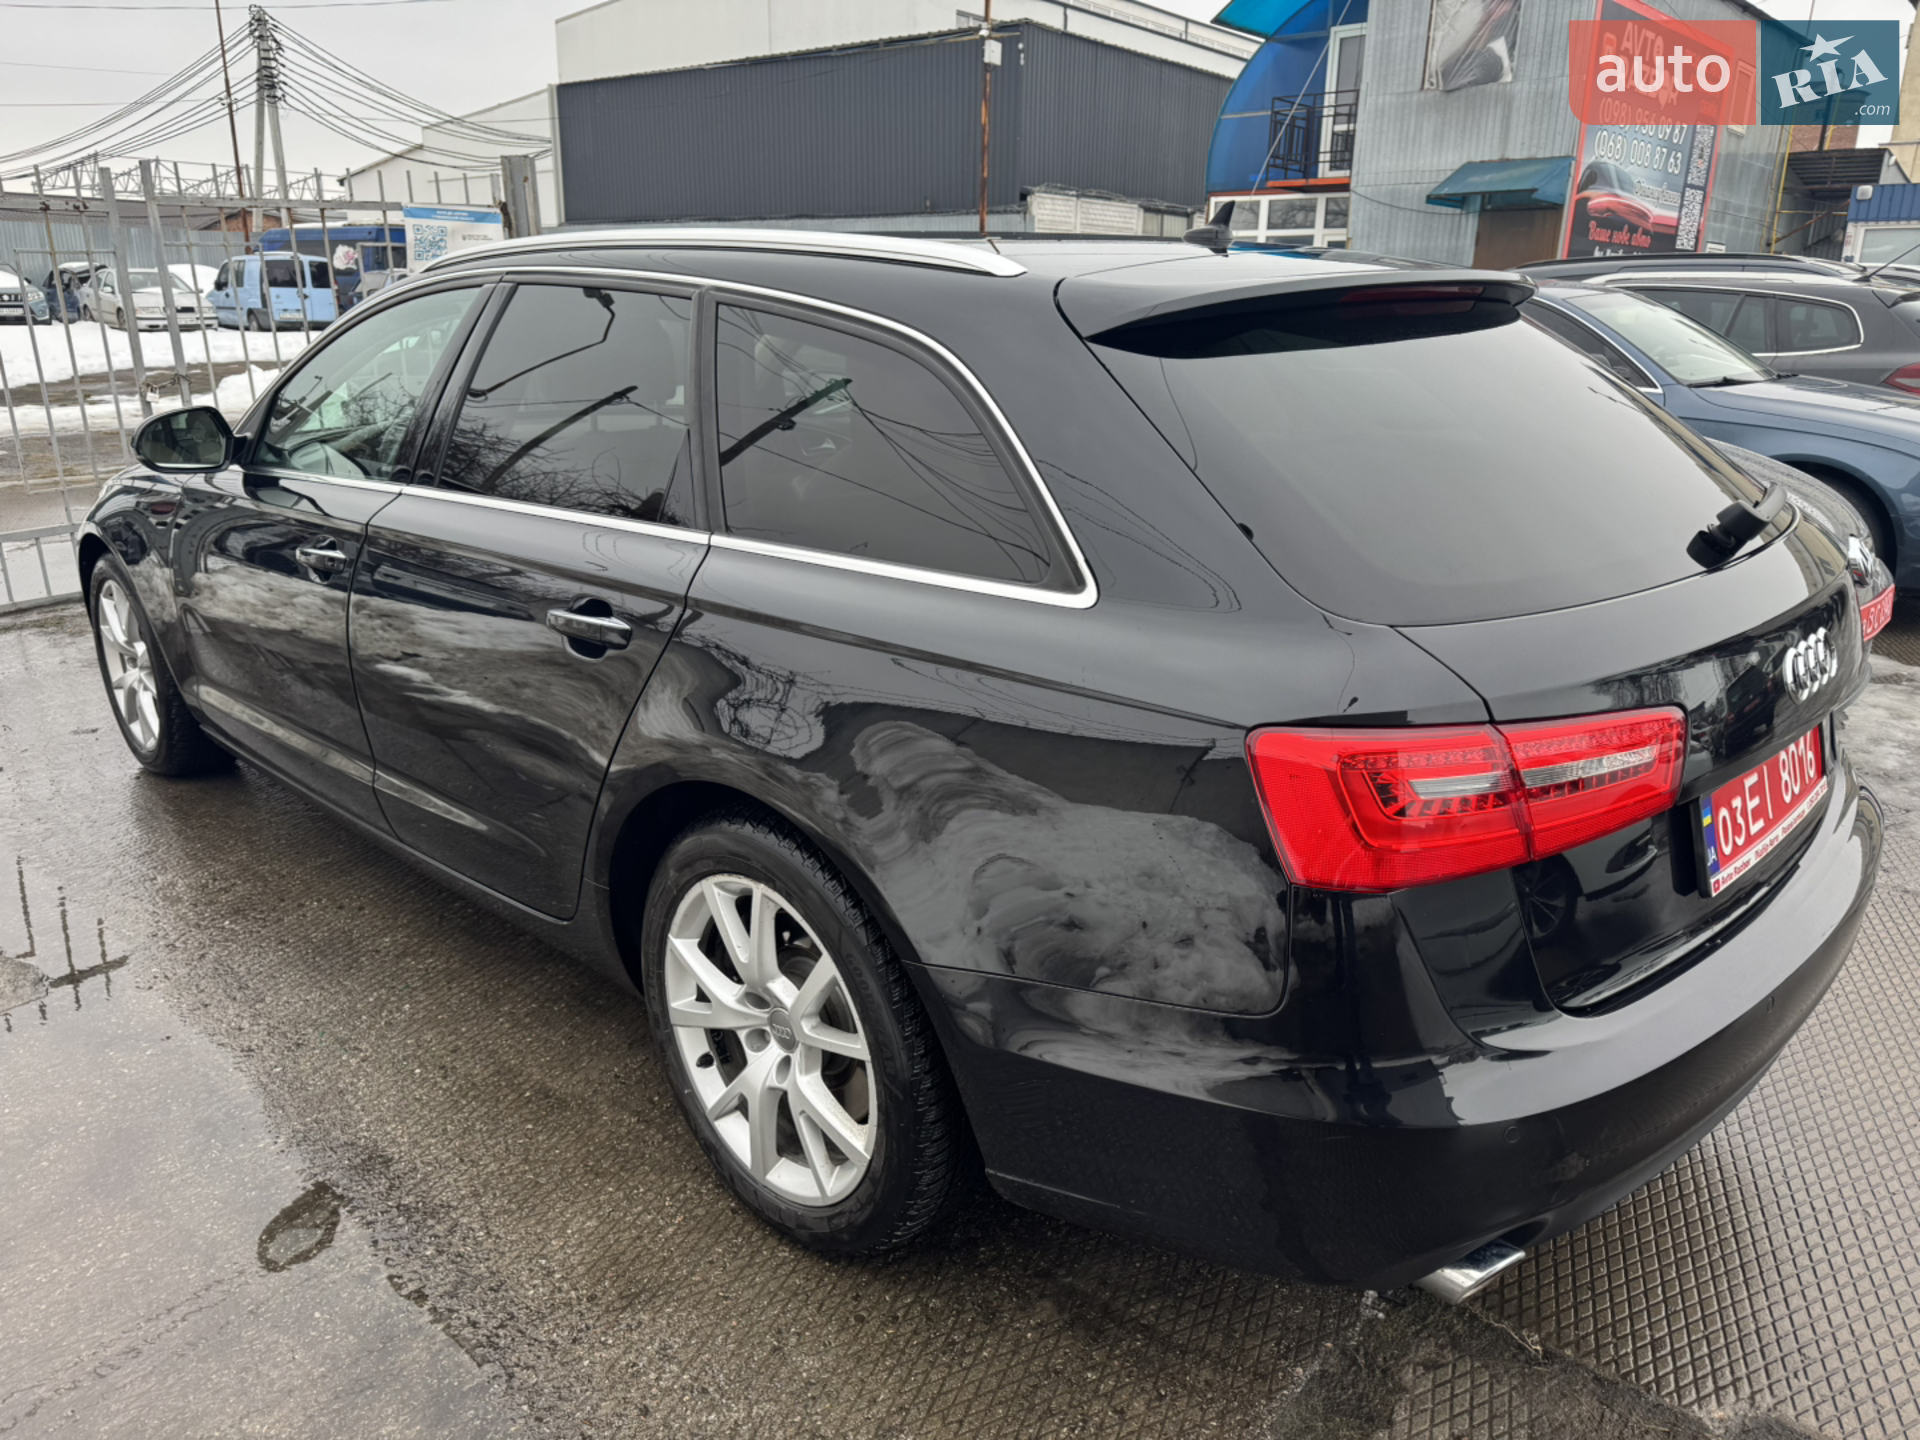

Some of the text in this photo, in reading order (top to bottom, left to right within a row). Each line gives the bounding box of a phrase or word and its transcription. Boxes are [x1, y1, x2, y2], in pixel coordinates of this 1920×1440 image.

[1635, 108, 1657, 137] 956
[1658, 115, 1673, 141] 09
[1672, 120, 1688, 145] 87
[1594, 129, 1683, 175] (068) 008 87 63
